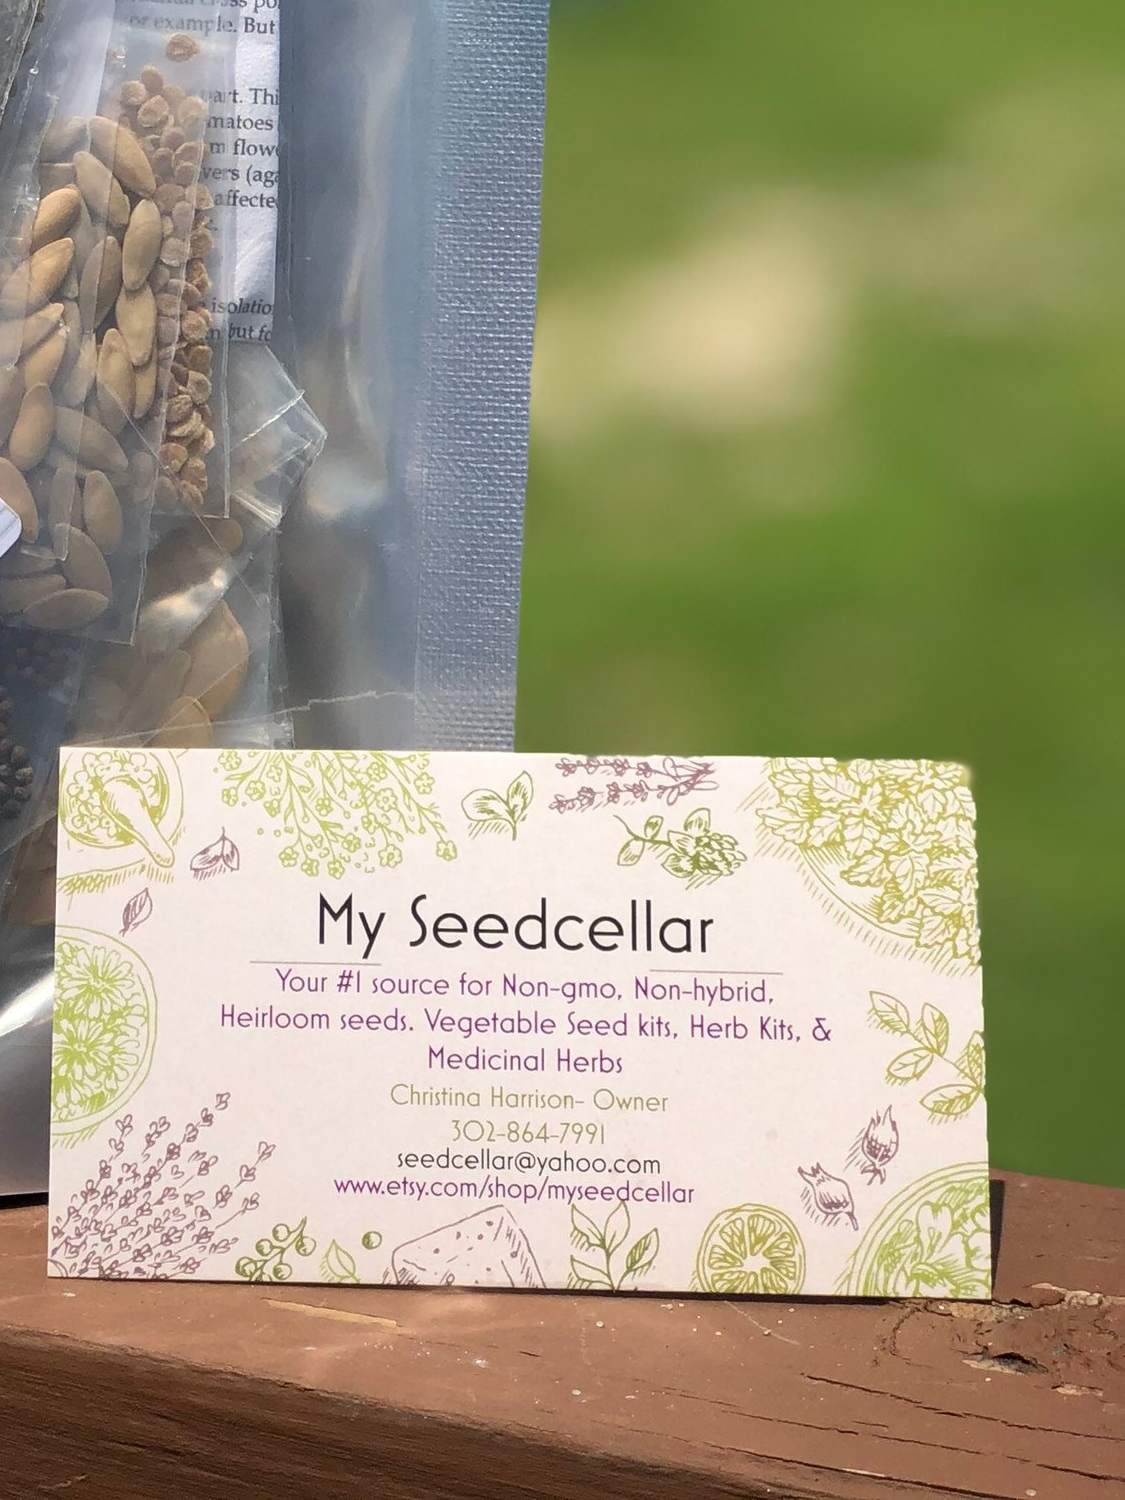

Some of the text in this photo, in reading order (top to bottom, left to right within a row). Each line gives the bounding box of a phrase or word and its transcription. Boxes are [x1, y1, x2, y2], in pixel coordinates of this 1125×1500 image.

[244, 16, 275, 34] But
[228, 323, 255, 340] but
[318, 892, 715, 960] My Seedcellar
[275, 968, 775, 1007] Your #1 source for Non-gmo, Non-hybrid,
[221, 1004, 832, 1042] Heirloom seeds. Vegetable Seed kits, Herb Kits, &
[428, 1044, 623, 1074] Medicinal Herbs
[390, 1083, 669, 1112] Christina Harrison- Owner
[451, 1119, 605, 1146] 302-864-7991
[397, 1148, 661, 1176] seedcellar@yahoo.com
[333, 1174, 695, 1205] www.etsy.com/shop/myseedcellar
